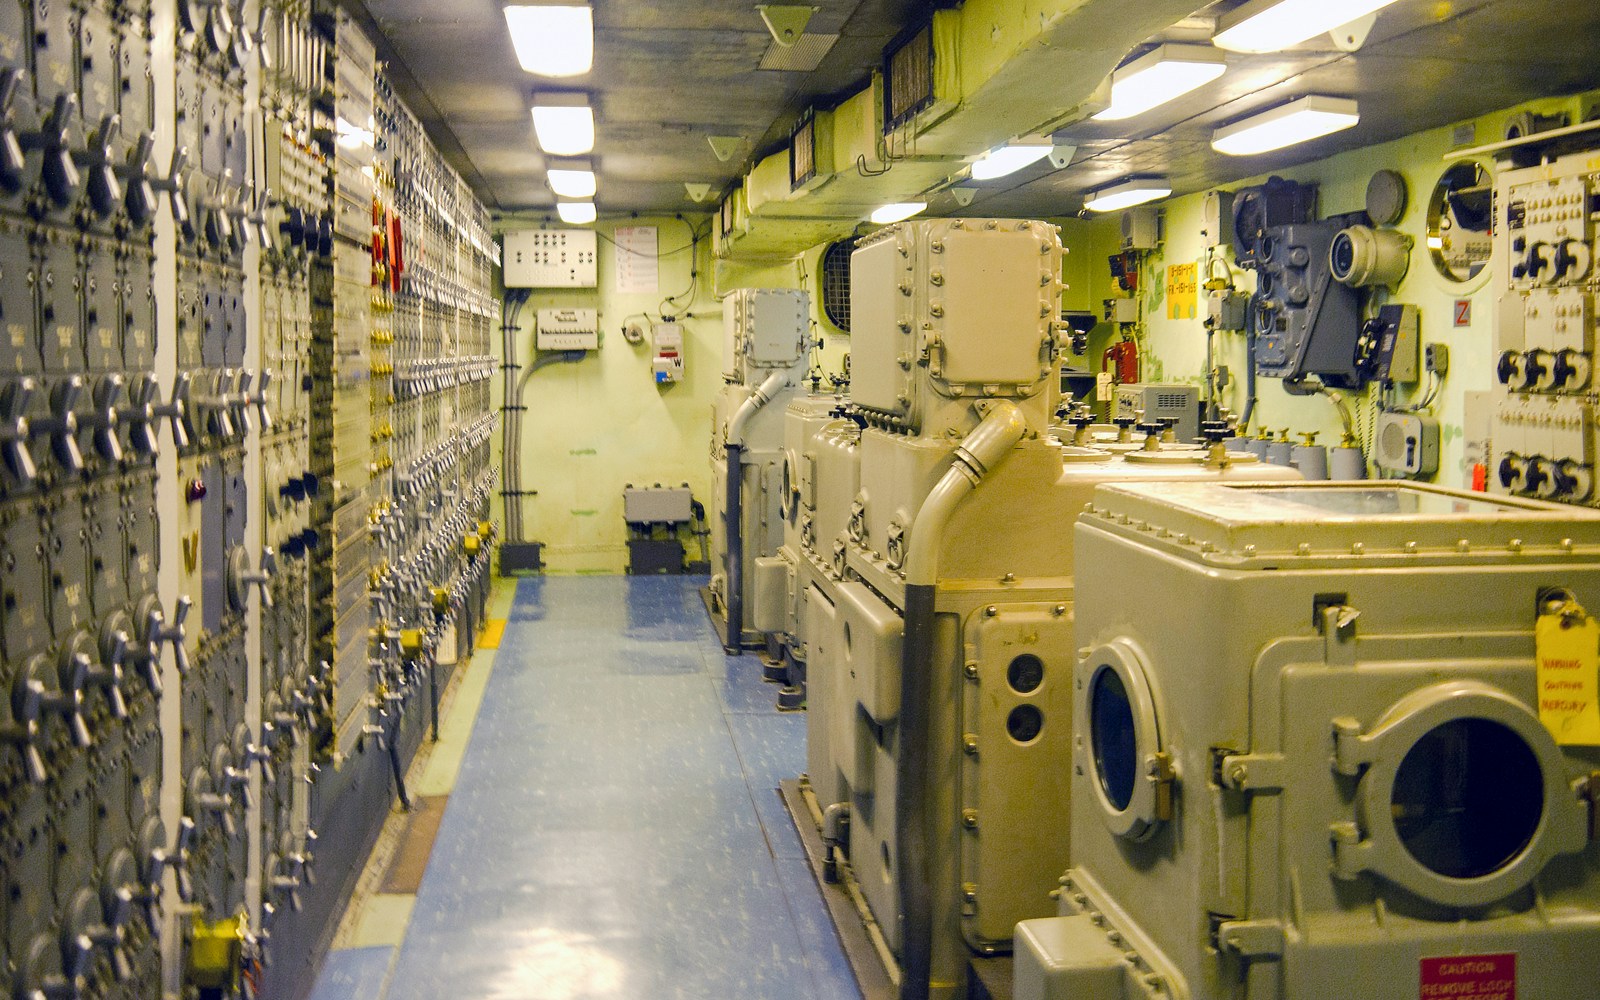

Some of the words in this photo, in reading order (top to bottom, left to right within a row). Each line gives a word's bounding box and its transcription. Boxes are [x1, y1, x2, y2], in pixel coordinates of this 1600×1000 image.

[1456, 301, 1469, 324] Z
[674, 358, 682, 367] W
[1542, 658, 1581, 669] WARNING
[1541, 699, 1586, 713] MERCURY
[1439, 962, 1495, 975] CAUTION
[1422, 982, 1475, 995] REMOVE
